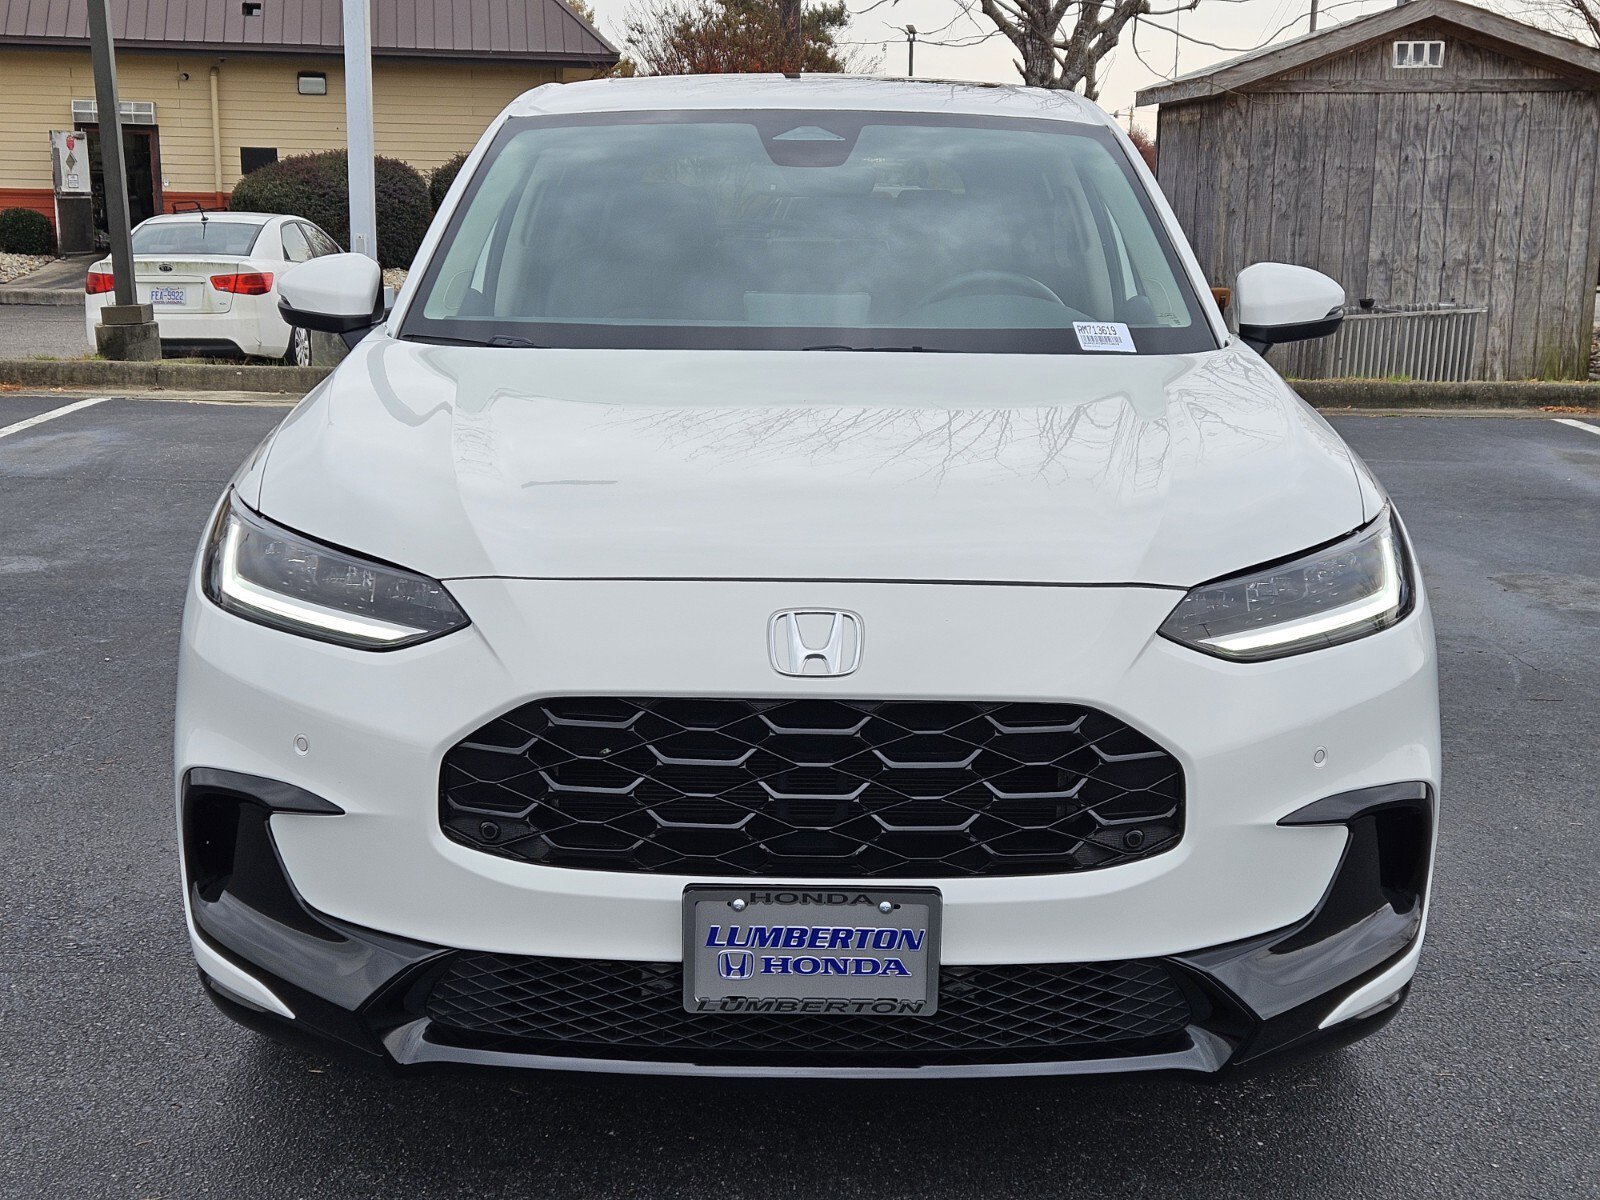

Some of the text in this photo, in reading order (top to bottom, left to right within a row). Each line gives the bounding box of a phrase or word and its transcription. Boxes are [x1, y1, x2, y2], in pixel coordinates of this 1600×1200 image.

[1077, 325, 1118, 336] RM713619
[750, 892, 875, 906] HONDA
[705, 924, 927, 951] LUMBERTON
[760, 955, 912, 977] HONDA
[696, 997, 926, 1014] LUMBERTON
